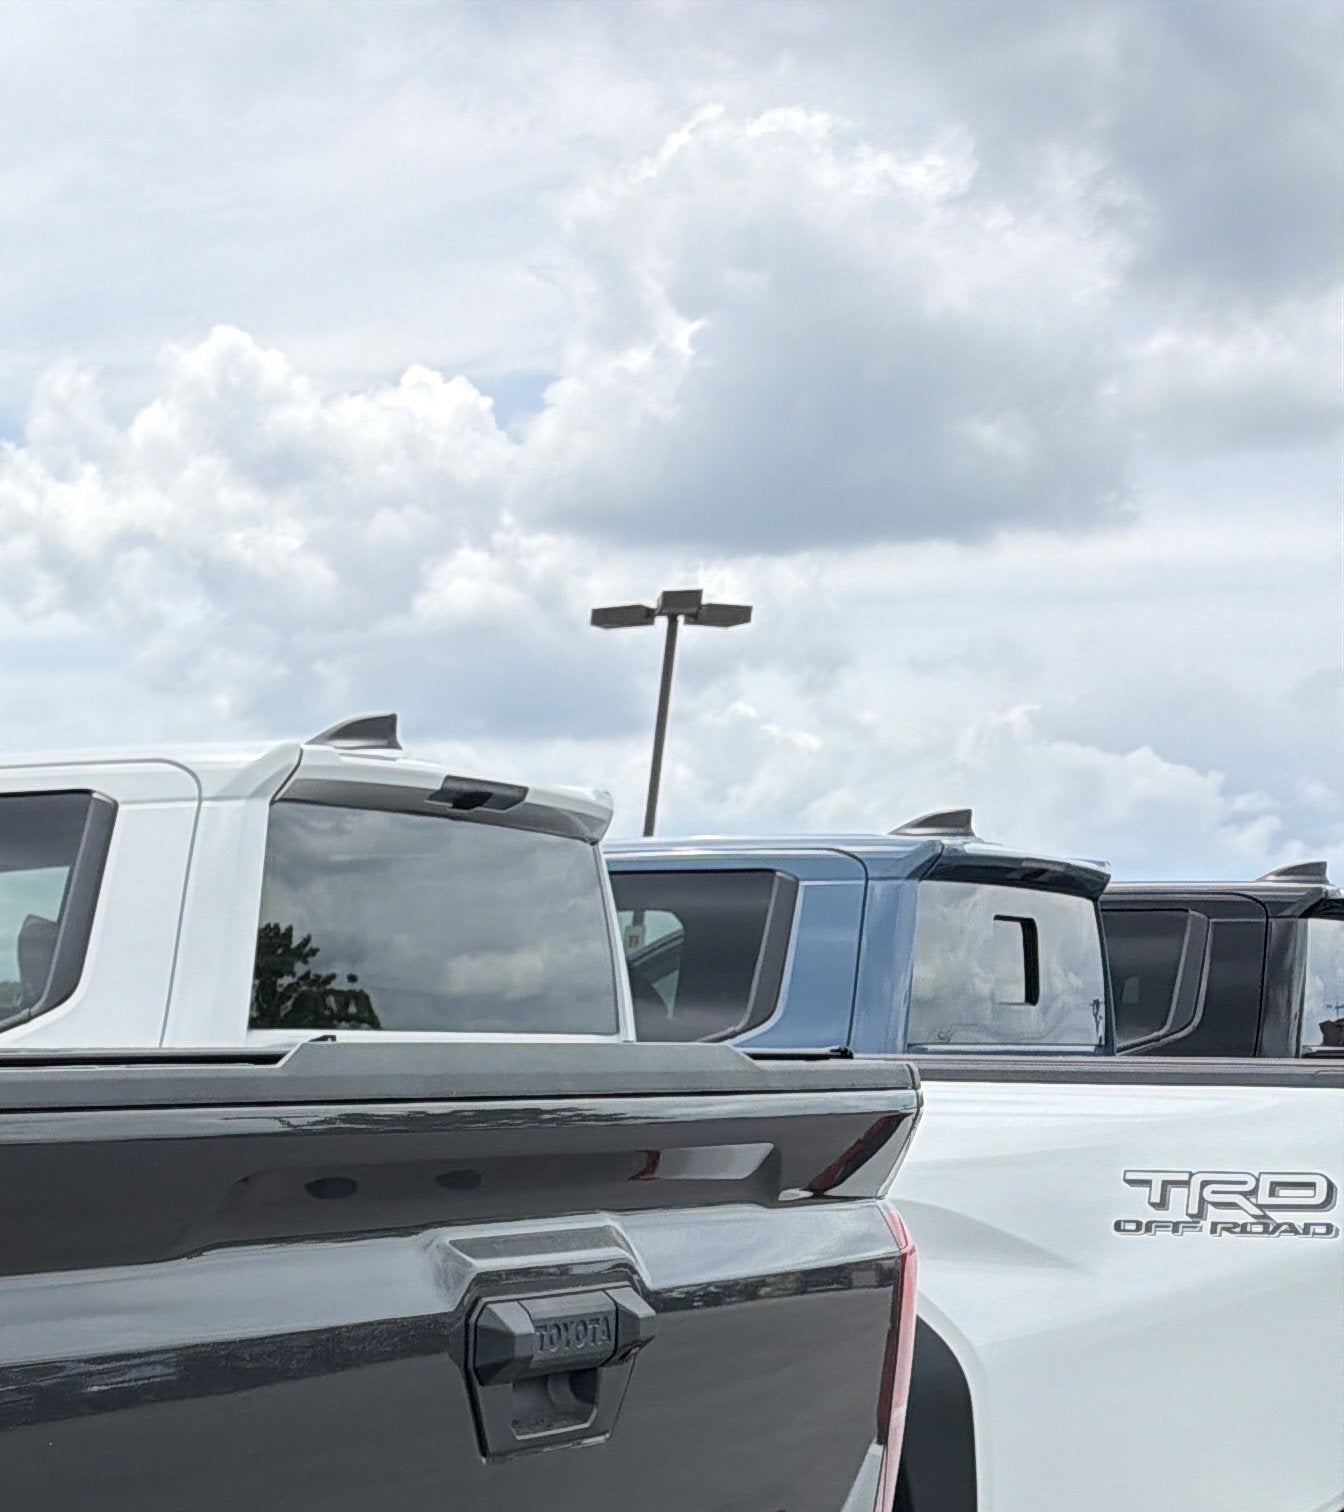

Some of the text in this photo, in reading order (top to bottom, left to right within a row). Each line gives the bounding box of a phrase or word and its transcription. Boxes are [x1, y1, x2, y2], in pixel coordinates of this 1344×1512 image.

[1122, 1170, 1338, 1222] TRD
[1113, 1219, 1339, 1239] OFF ROAD
[534, 1315, 613, 1354] TOYOTA
